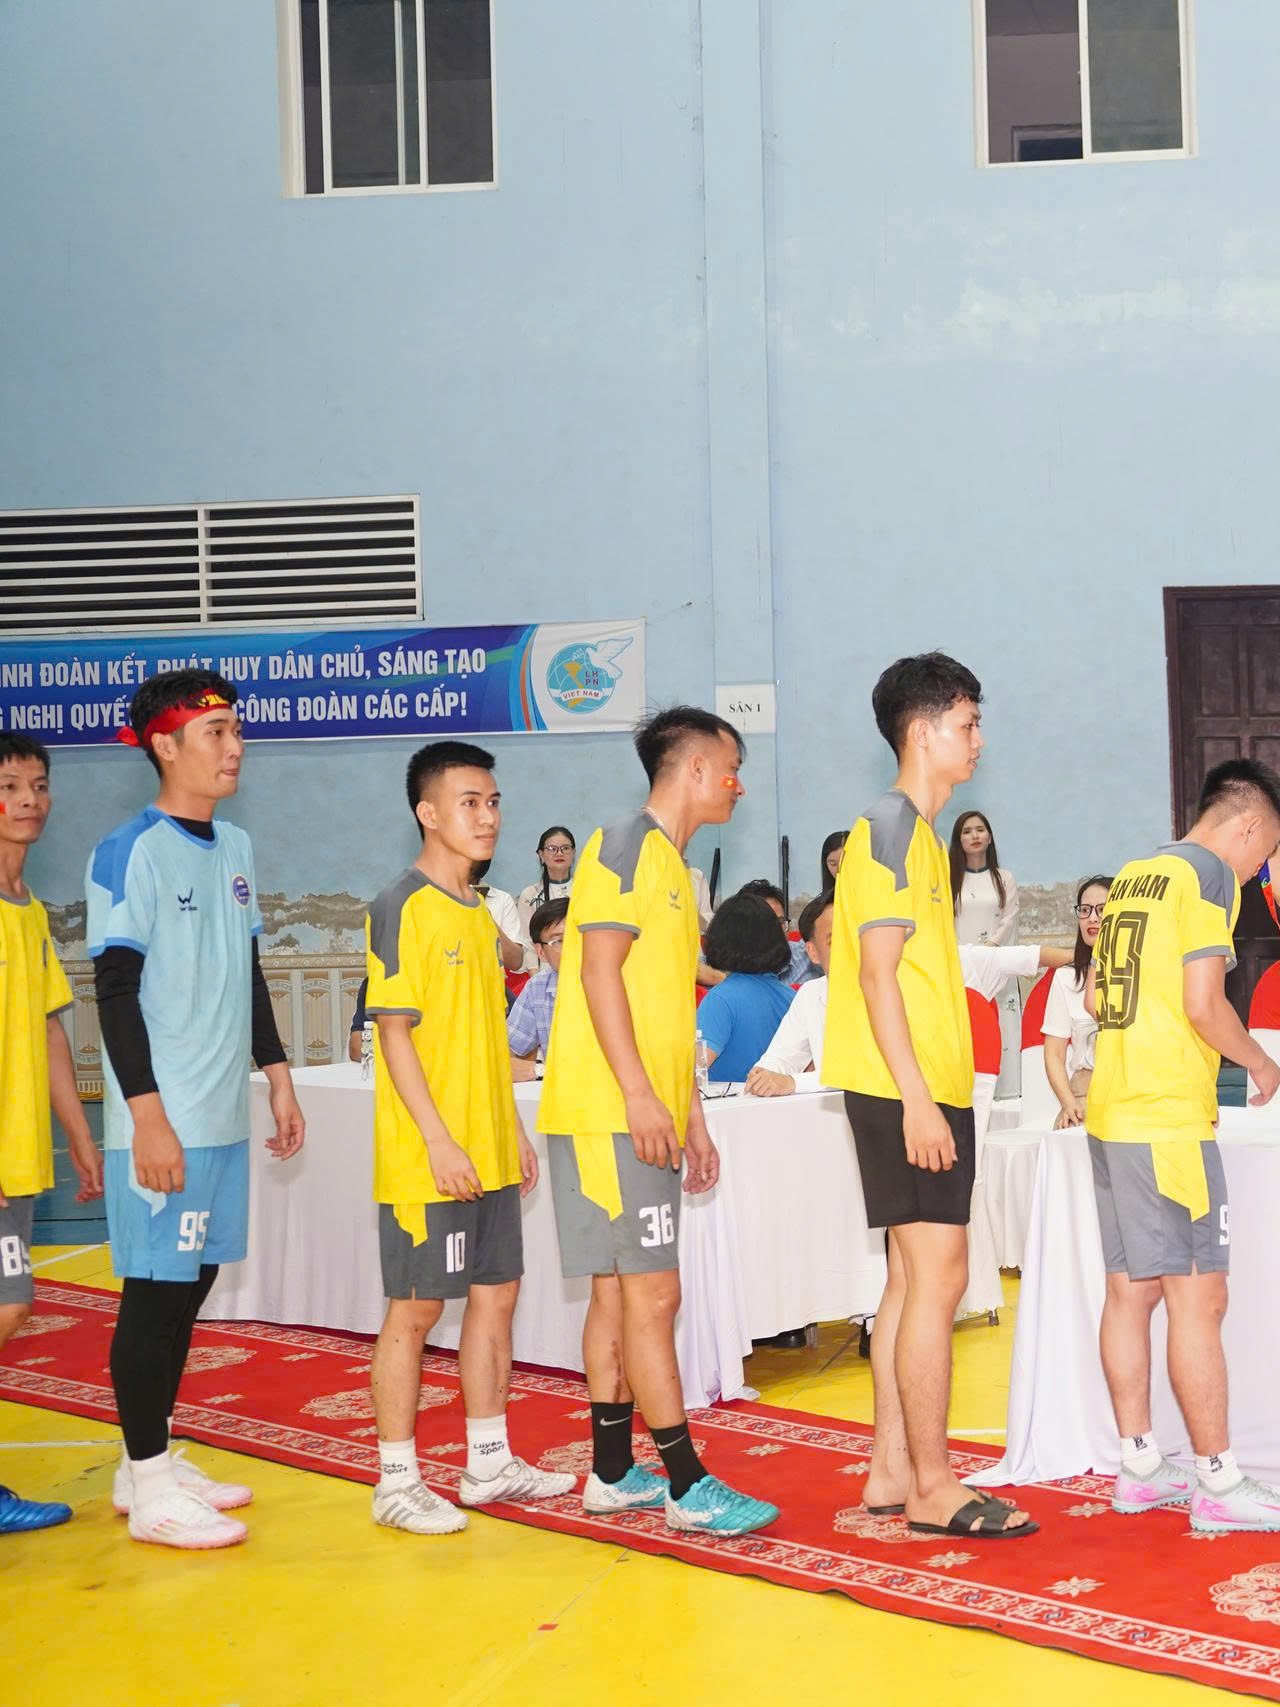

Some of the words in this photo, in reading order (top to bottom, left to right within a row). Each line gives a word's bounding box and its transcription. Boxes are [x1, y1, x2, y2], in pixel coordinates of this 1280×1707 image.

[40, 656, 100, 687] ĐOÀN
[219, 656, 262, 681] HUY
[269, 650, 314, 680] DÂN
[320, 644, 371, 680] CHỦ,
[378, 646, 438, 677] SÁNG
[444, 648, 486, 679] TẠO
[11, 704, 62, 734] NGHỊ
[233, 693, 290, 723] CÔNG
[297, 690, 358, 721] ĐOÀN
[364, 689, 408, 719] CÁC
[415, 683, 467, 718] CẤP!
[729, 700, 753, 713] SÂN
[1127, 874, 1170, 901] NAM
[638, 1203, 675, 1248] 36
[446, 1231, 466, 1273] 10
